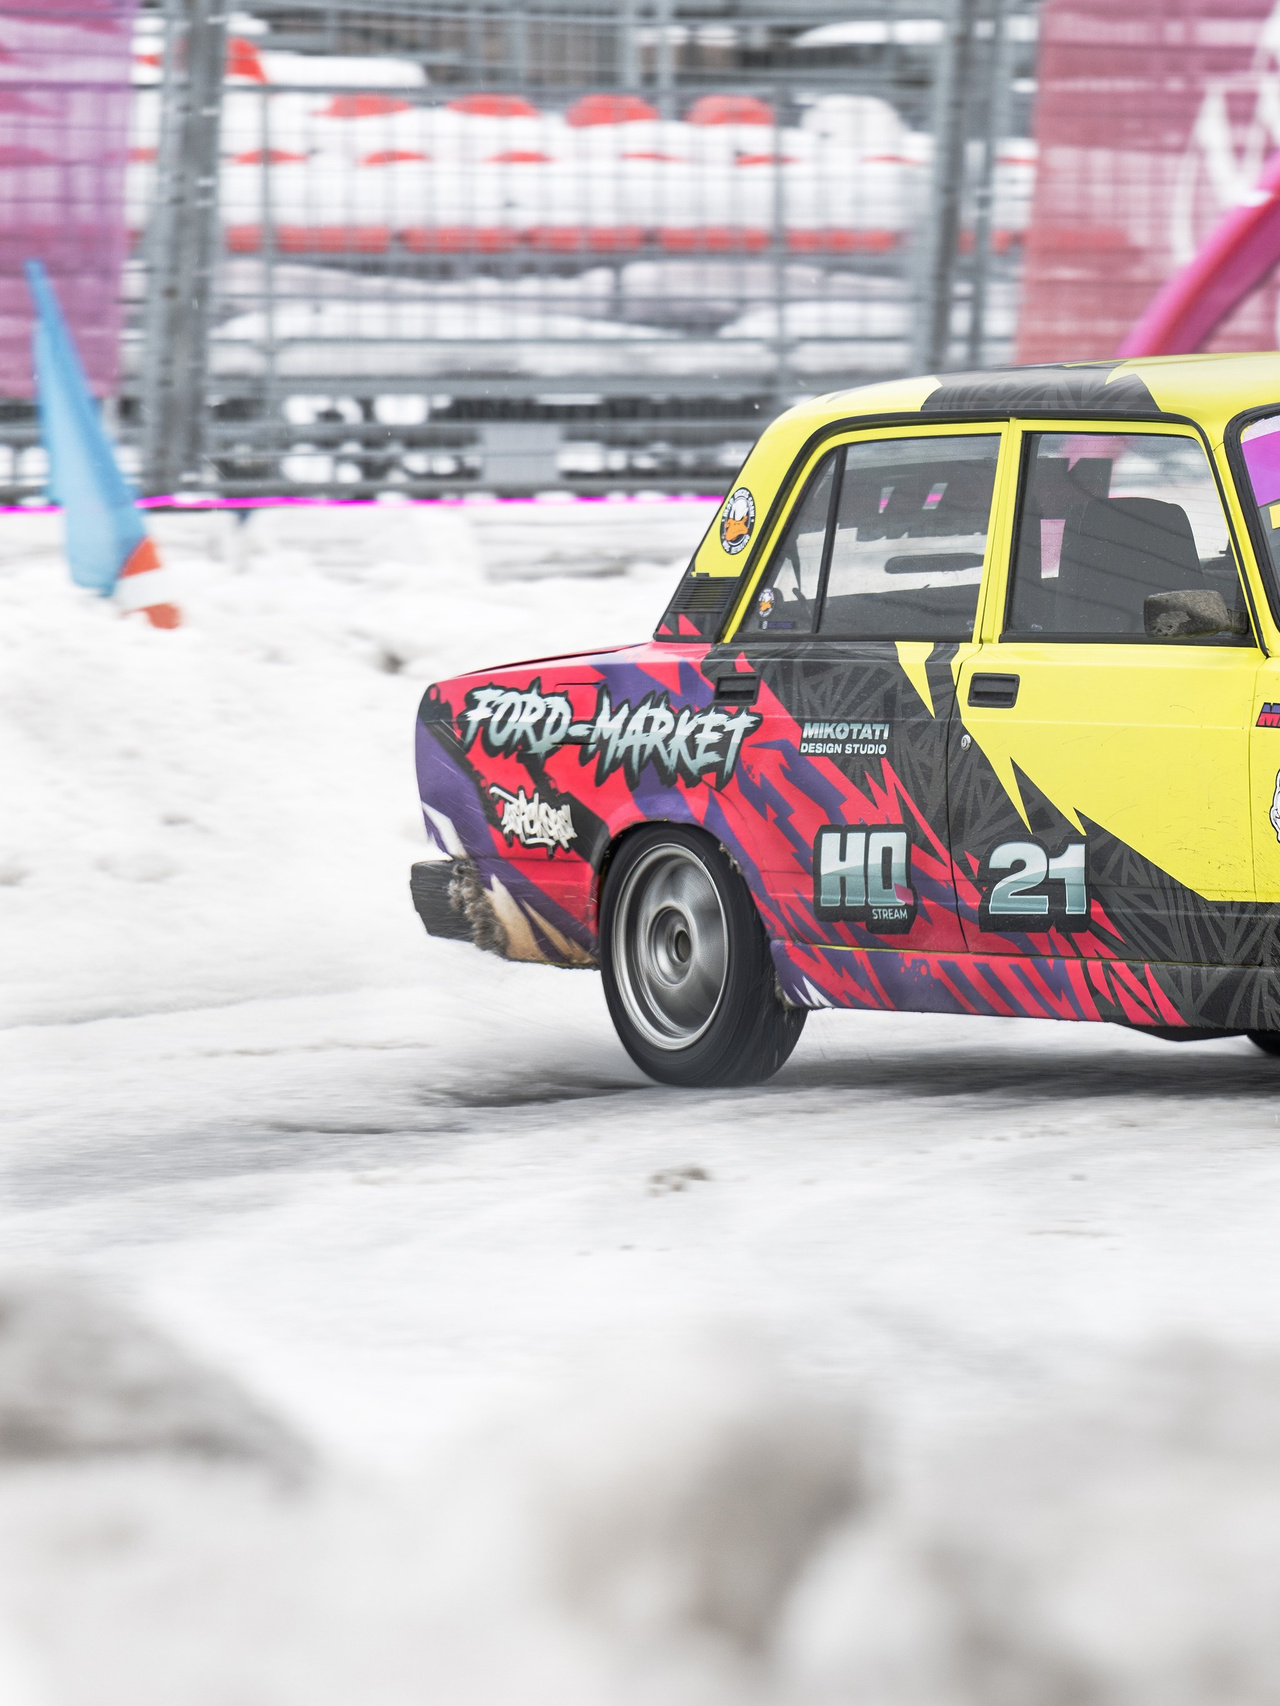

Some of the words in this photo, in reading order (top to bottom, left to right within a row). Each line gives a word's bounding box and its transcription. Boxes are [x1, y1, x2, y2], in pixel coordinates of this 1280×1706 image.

[802, 722, 890, 740] MIKOTATI
[800, 742, 842, 754] DESIGN
[844, 742, 887, 755] STUDIO
[988, 841, 1087, 915] 21
[872, 908, 908, 920] STREAM
